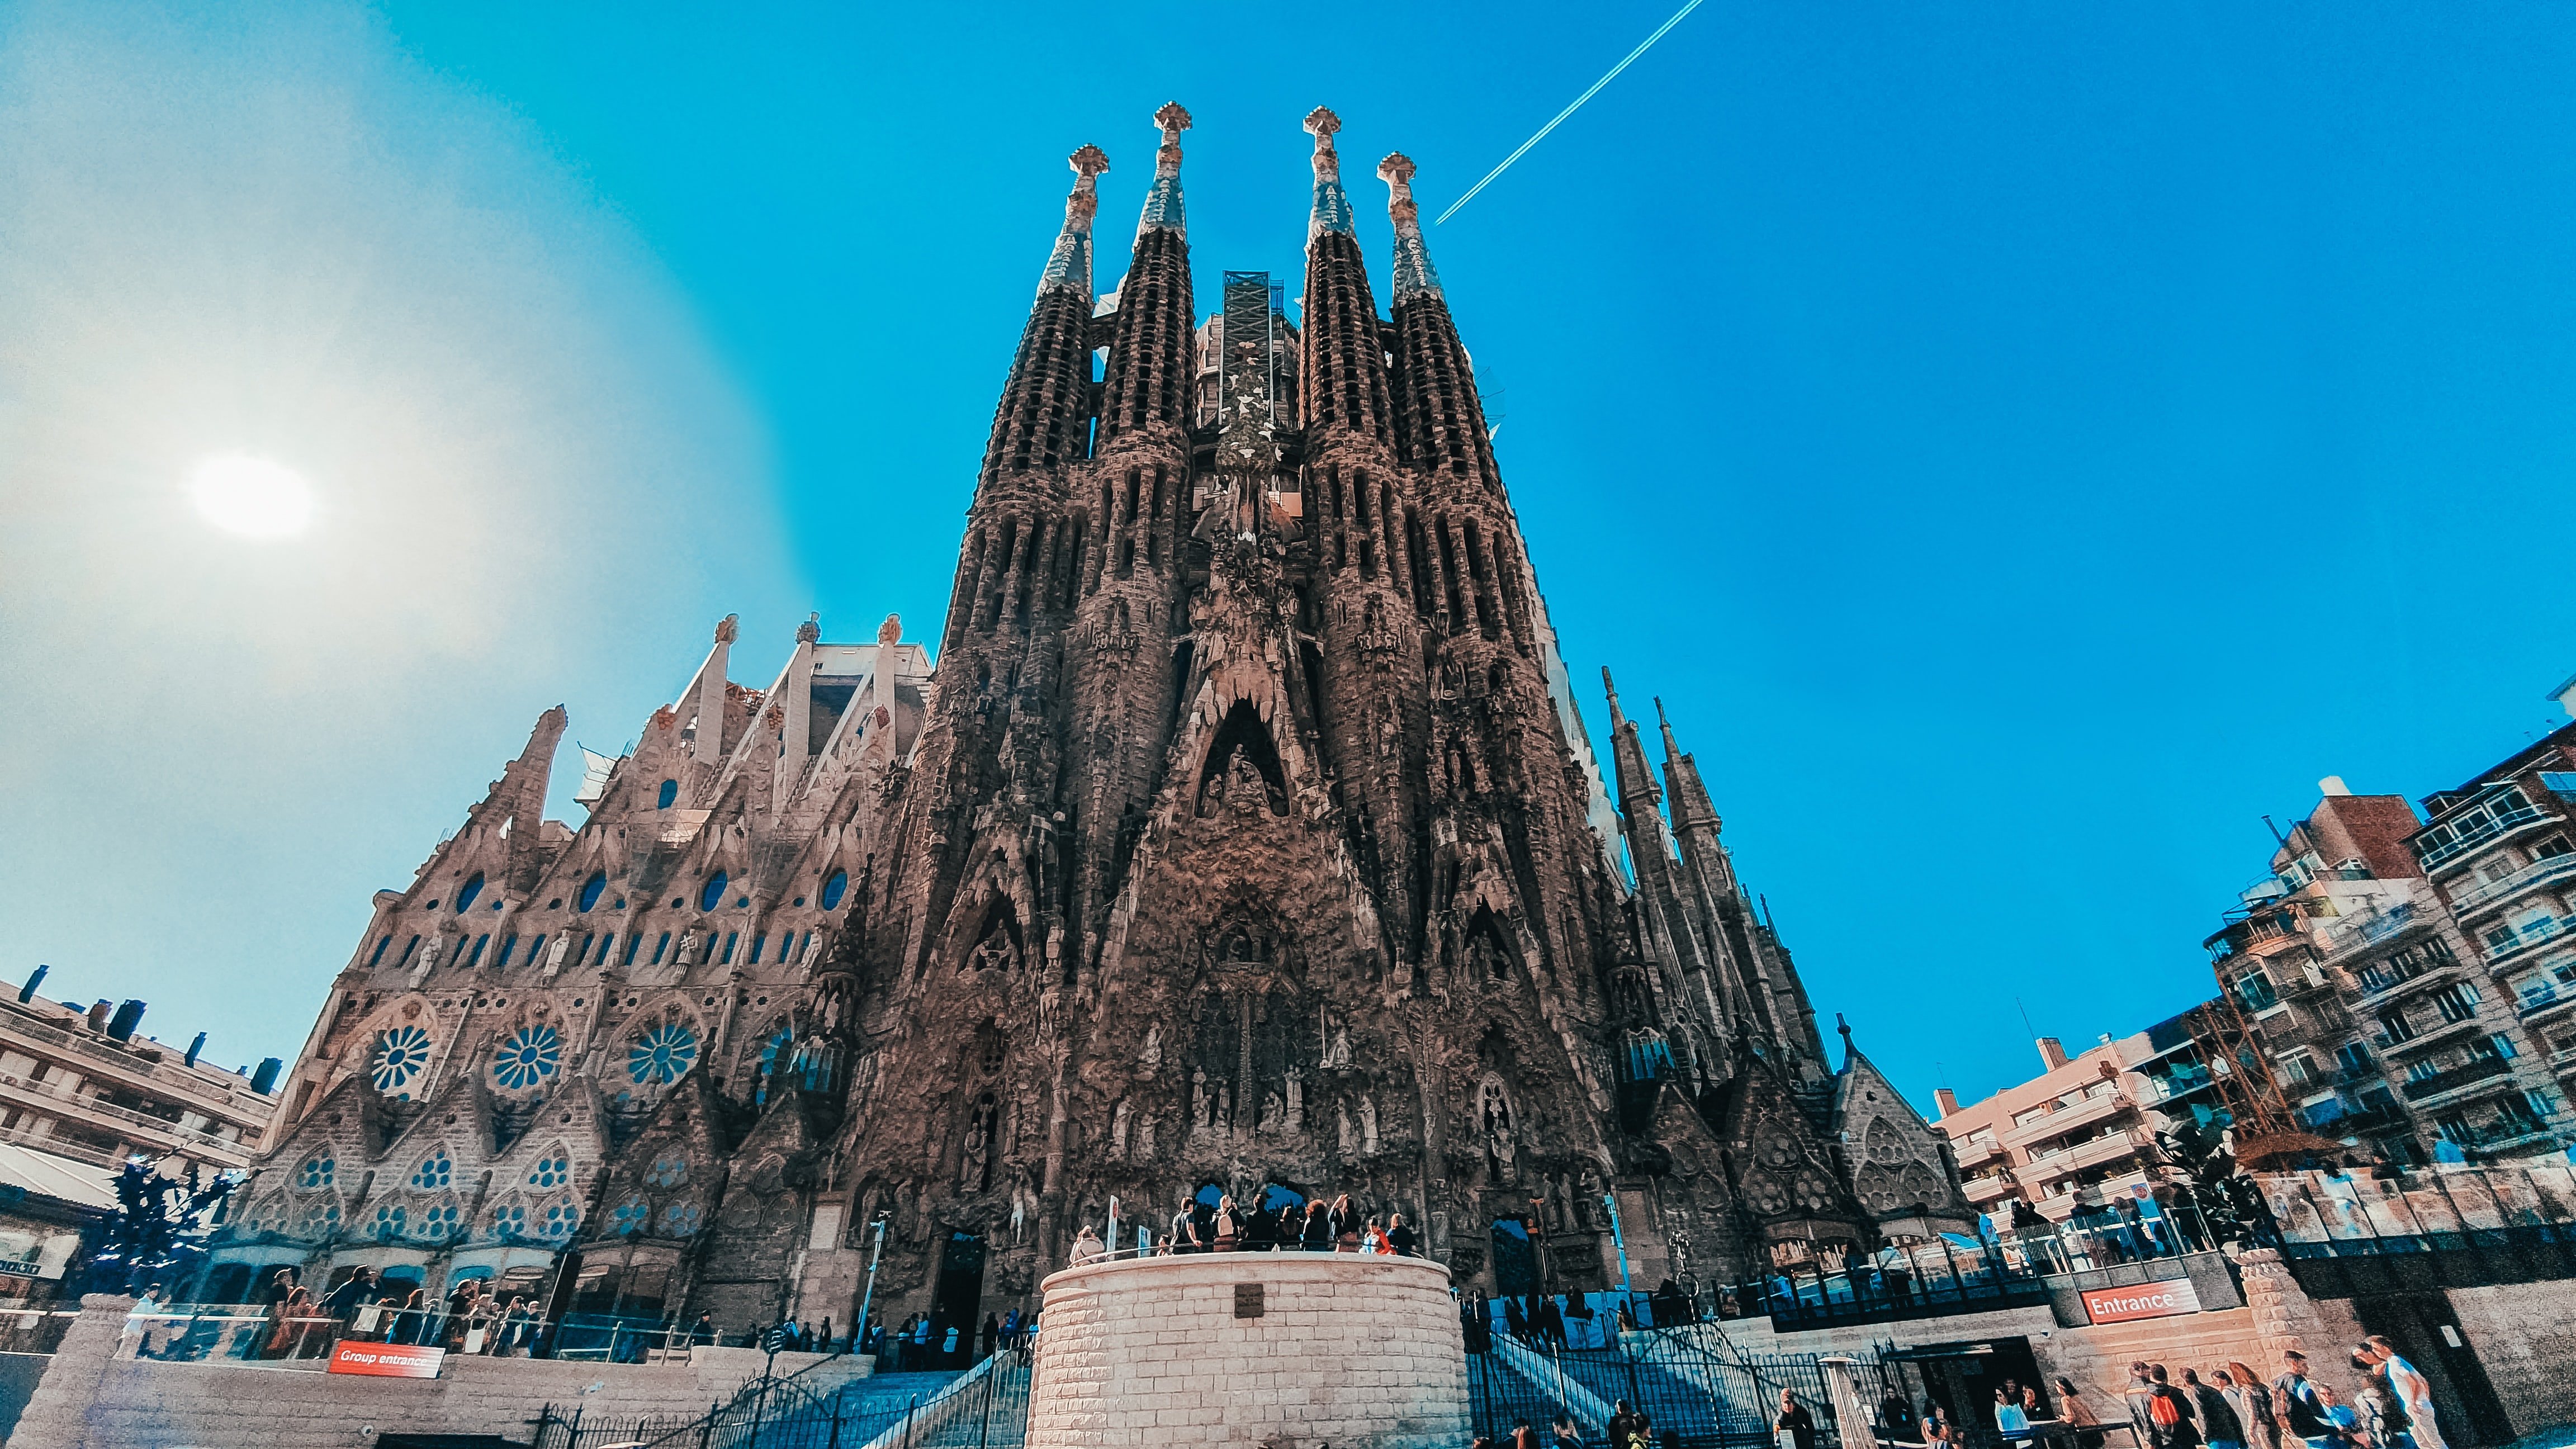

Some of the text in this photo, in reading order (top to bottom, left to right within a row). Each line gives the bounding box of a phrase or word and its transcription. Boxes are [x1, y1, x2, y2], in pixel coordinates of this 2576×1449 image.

[2090, 1293, 2174, 1315] Entrance
[340, 1350, 427, 1366] Group entrance
